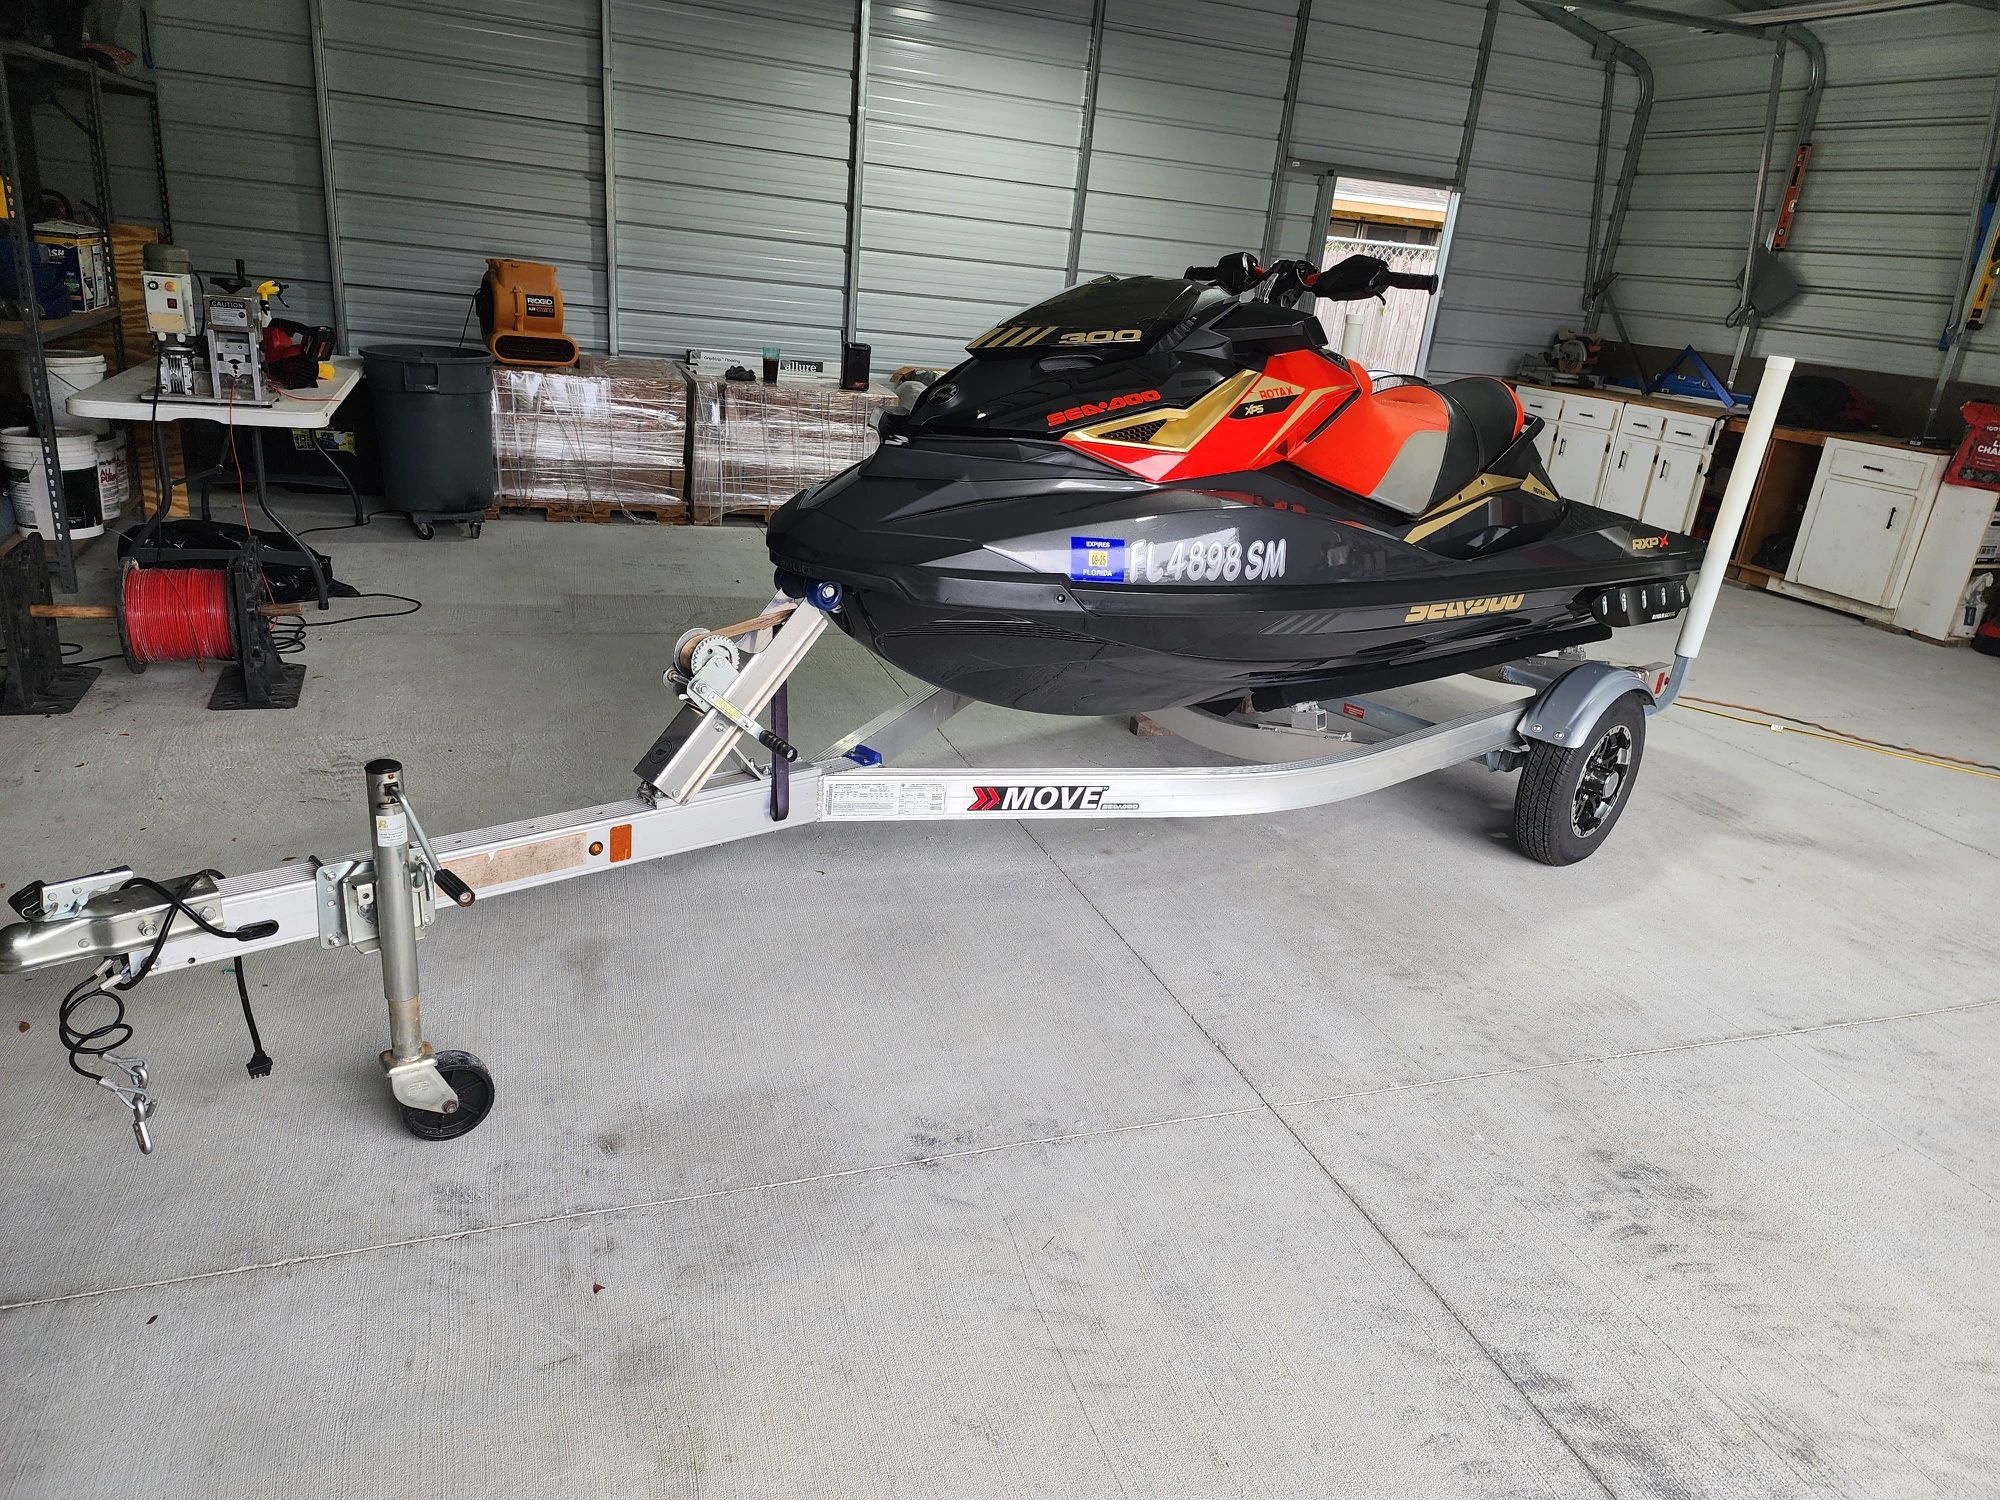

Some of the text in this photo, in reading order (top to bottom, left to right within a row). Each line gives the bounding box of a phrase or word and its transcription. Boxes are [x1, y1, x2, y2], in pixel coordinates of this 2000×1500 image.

[211, 300, 244, 308] CAUTION
[527, 297, 553, 305] RIDGID
[1059, 329, 1142, 343] 300
[784, 361, 817, 372] allure
[1259, 386, 1294, 399] ROTAX
[1245, 404, 1264, 416] XPS
[100, 468, 113, 477] ALL
[1129, 538, 1287, 583] FL 4898 SM
[1082, 569, 1113, 577] FLORIDA
